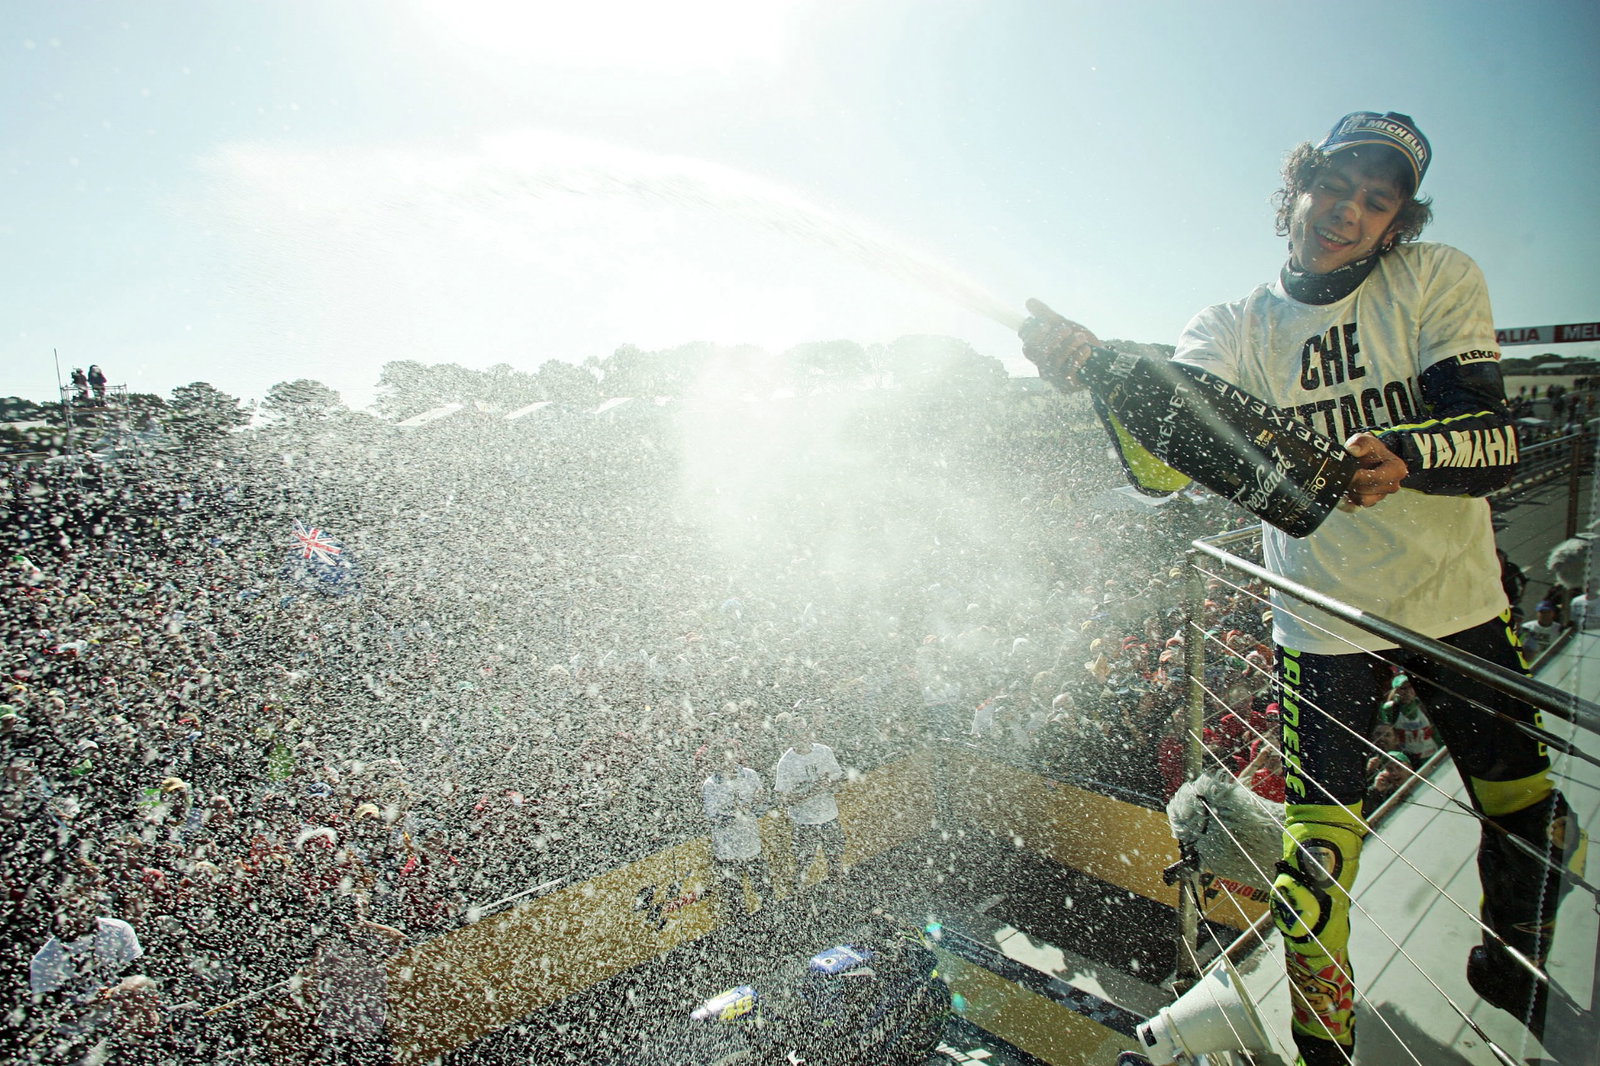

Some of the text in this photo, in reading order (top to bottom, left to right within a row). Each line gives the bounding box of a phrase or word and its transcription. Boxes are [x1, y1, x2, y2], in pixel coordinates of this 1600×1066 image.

[1366, 120, 1425, 160] MICHELIN
[1300, 322, 1366, 391] CHE
[1194, 373, 1347, 462] FREIXENET
[1277, 377, 1421, 443] TTACO
[1411, 425, 1518, 469] YAMAHA
[1297, 477, 1327, 516] NEGRO
